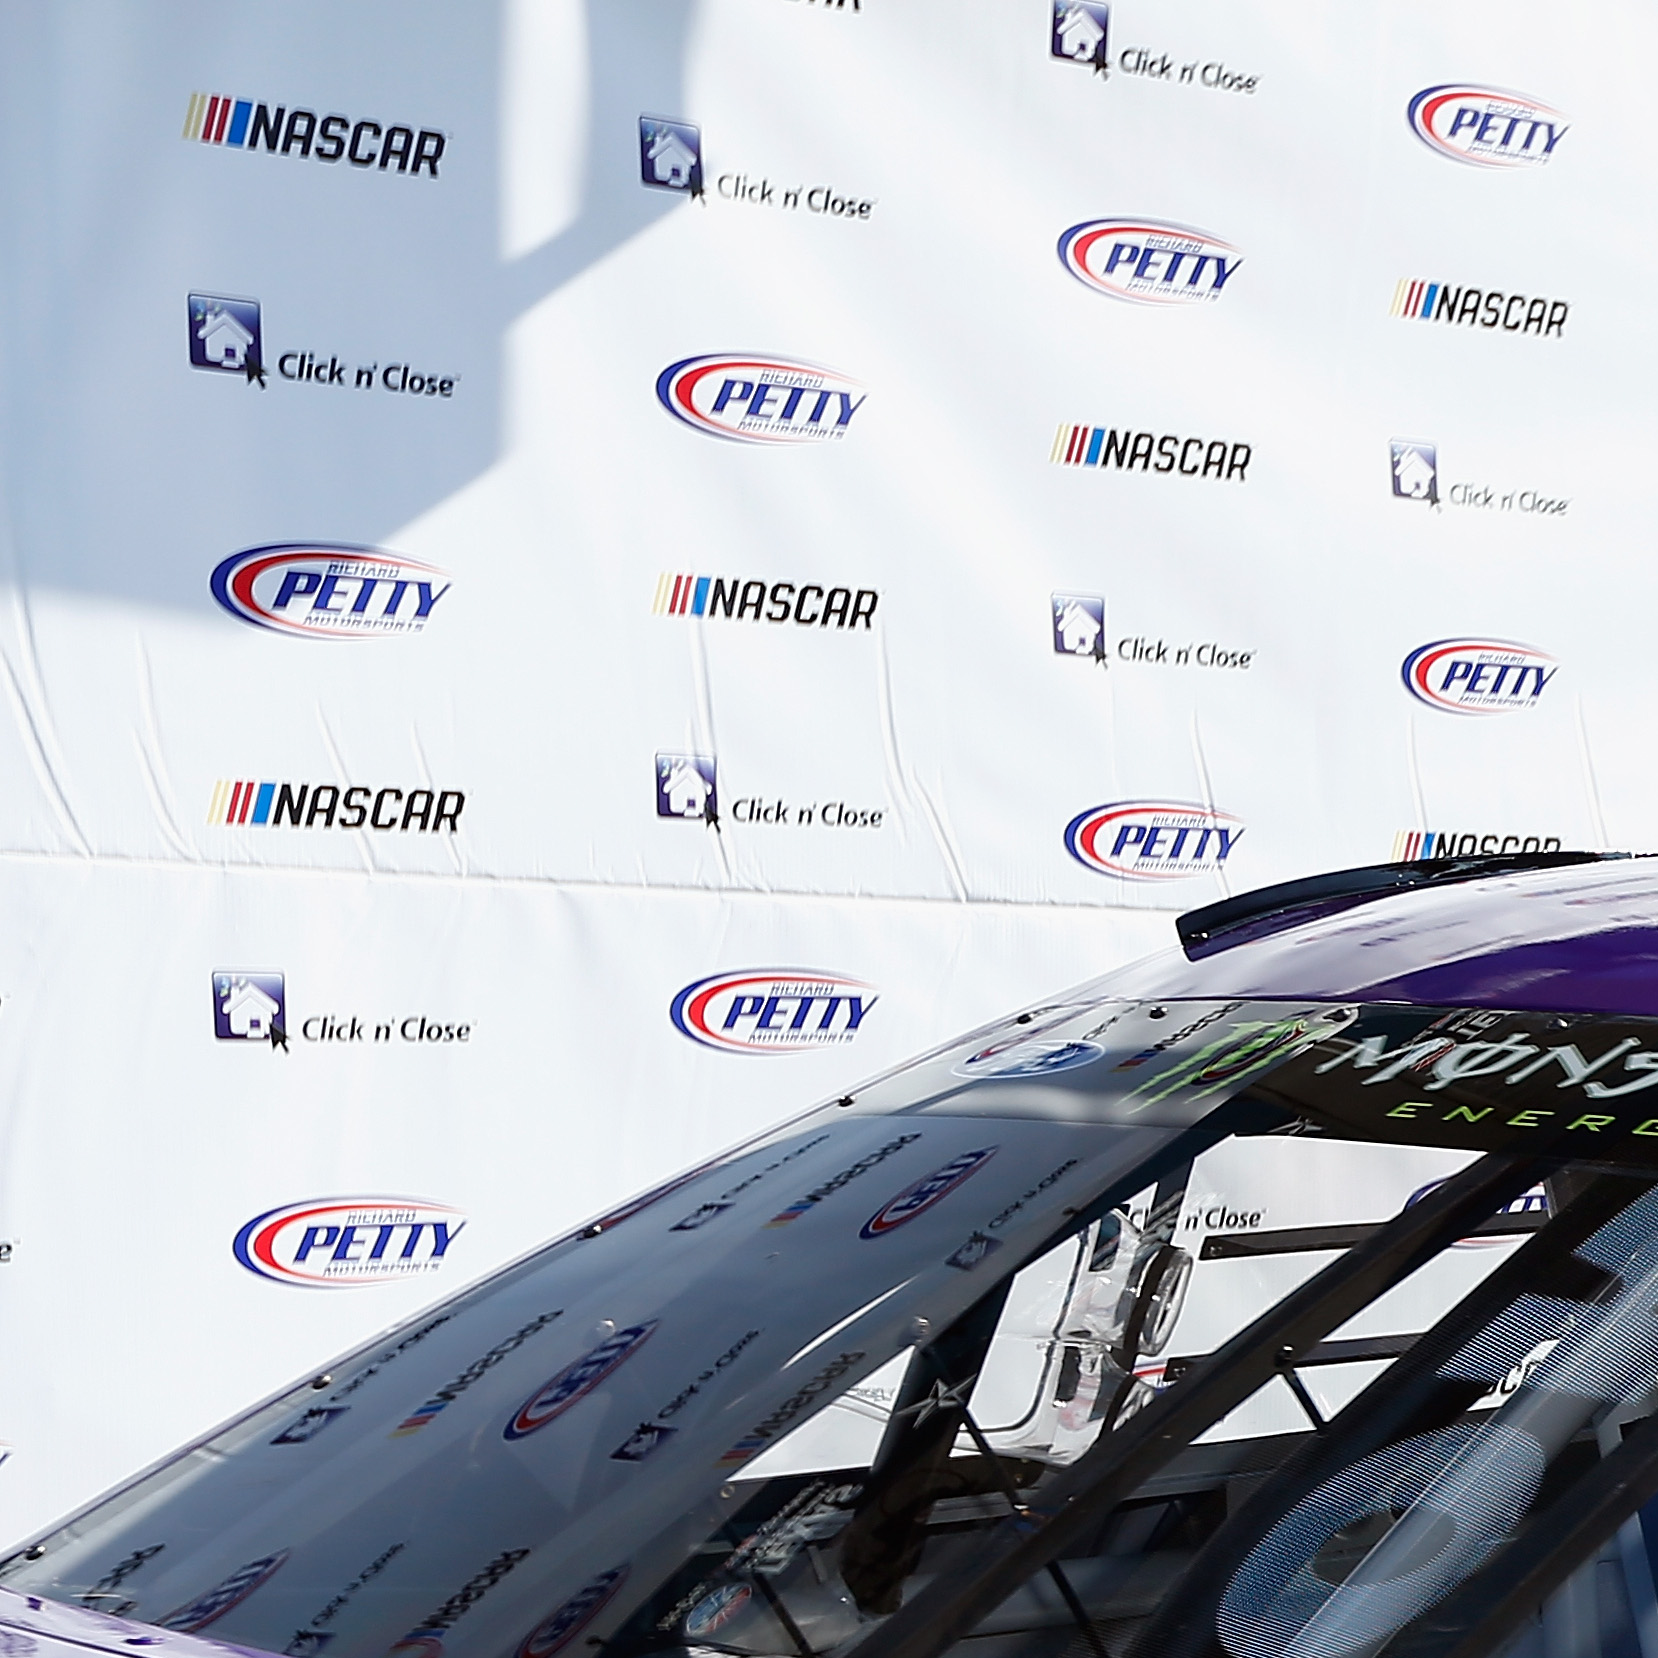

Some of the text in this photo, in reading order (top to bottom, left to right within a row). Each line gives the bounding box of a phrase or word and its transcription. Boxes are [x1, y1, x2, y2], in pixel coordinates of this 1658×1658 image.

[1120, 49, 1172, 78] Click
[1201, 62, 1256, 94] Close
[248, 103, 446, 177] NASCAR
[1448, 107, 1571, 155] PETTY
[718, 174, 774, 203] Click
[809, 188, 872, 219] Close
[1103, 241, 1244, 289] PETTY
[1435, 286, 1568, 338] NASCAR
[278, 353, 344, 386] Click
[382, 363, 455, 398] Close
[760, 368, 825, 389] RICHARD
[709, 378, 868, 426] PETTY
[1101, 430, 1251, 481] NASCAR
[328, 561, 400, 579] RICHARD
[272, 571, 452, 618] PETTY
[710, 579, 879, 630] NASCAR
[1118, 637, 1167, 663] Click
[1196, 641, 1251, 669] Close
[1439, 660, 1560, 698] PETTY
[272, 784, 466, 831] NASCAR
[732, 798, 788, 824] Click
[821, 802, 883, 827] Close
[1151, 815, 1207, 827] RICHARD
[1110, 824, 1246, 860] PETTY
[770, 982, 834, 996] RICHARD
[302, 1017, 363, 1042] Click
[400, 1017, 471, 1042] Close
[722, 994, 879, 1030] PETTY
[347, 1209, 416, 1224] RICHARD
[1205, 1206, 1262, 1231] Close
[292, 1221, 467, 1266] PETTY
